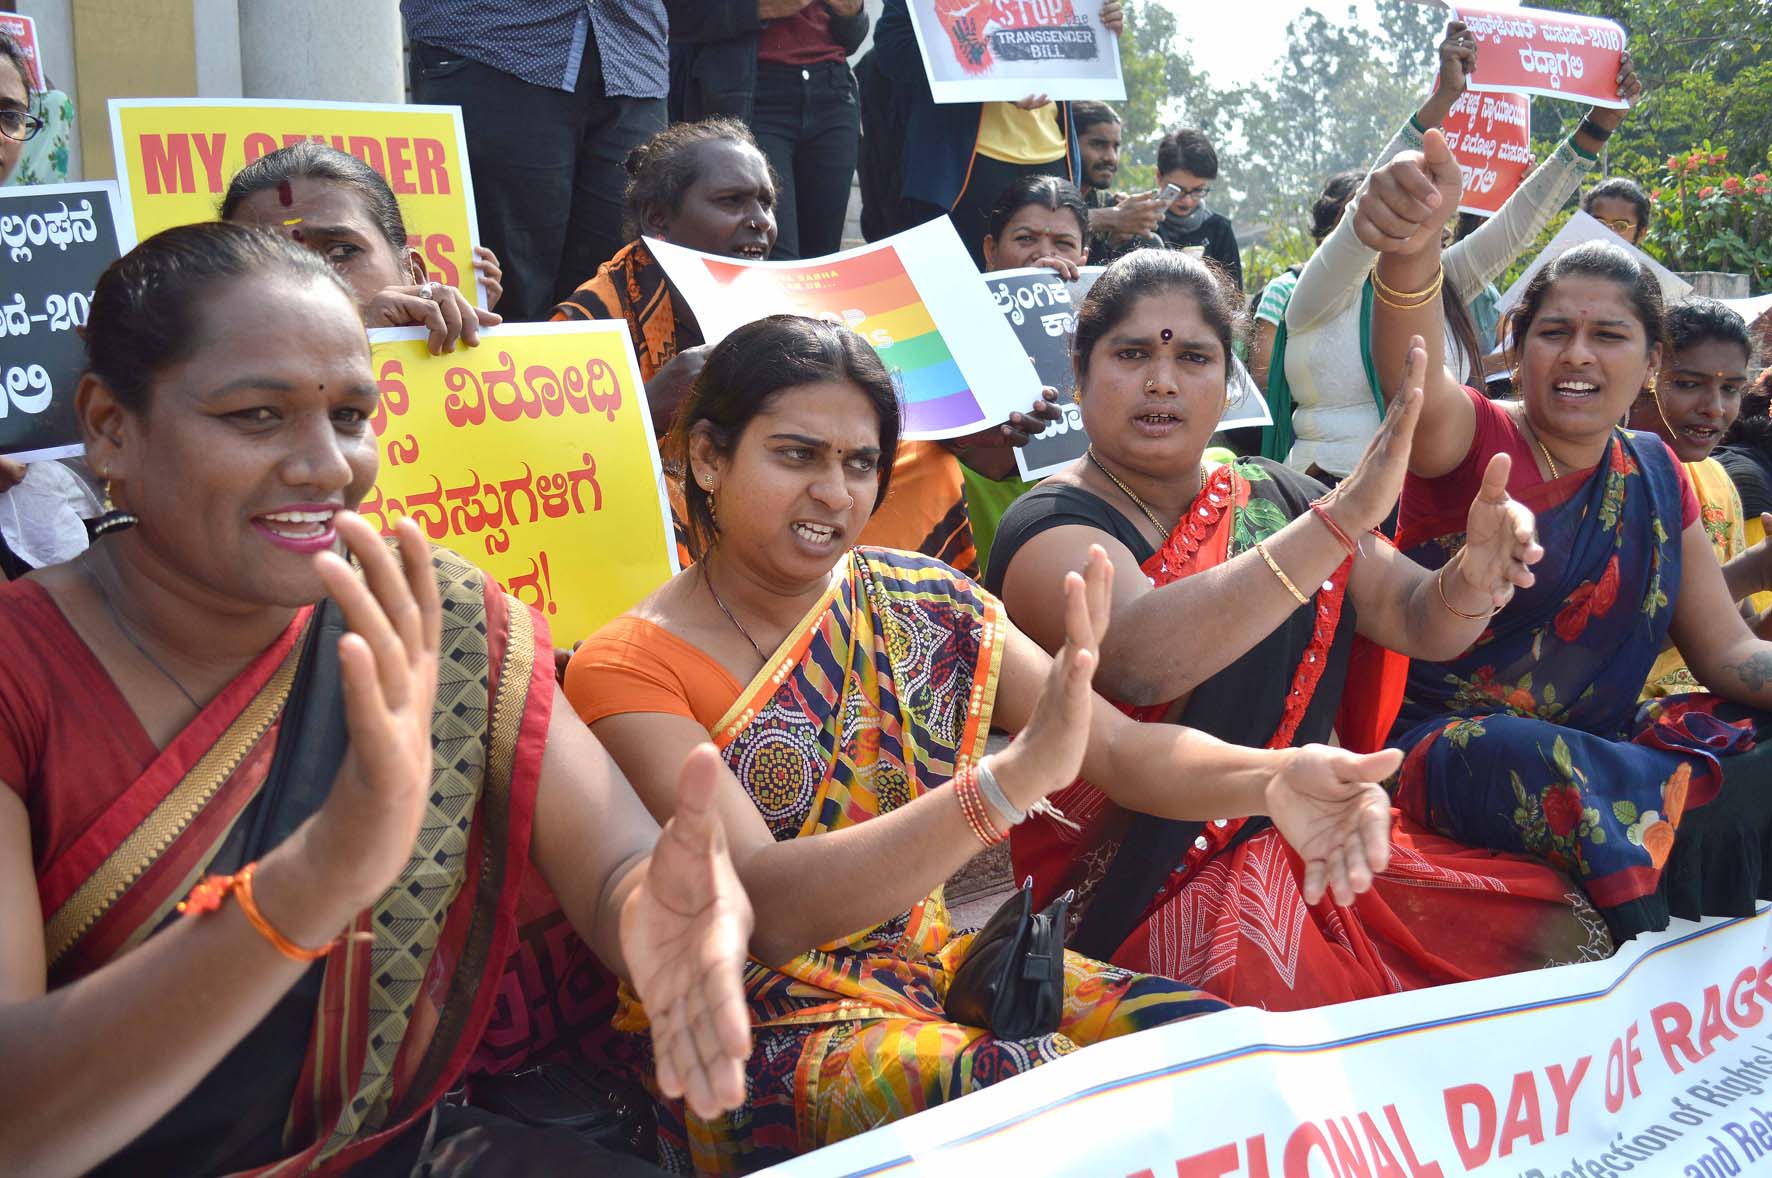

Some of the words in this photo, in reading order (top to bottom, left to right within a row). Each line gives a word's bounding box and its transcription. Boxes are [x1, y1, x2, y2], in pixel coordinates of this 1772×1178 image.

[994, 0, 1063, 27] STOP
[996, 31, 1093, 44] TRANSGENDER
[1030, 44, 1065, 59] BILL
[140, 133, 227, 194] MY
[0, 200, 98, 263] ಲ್ಲಂಘನೆ
[443, 351, 622, 428] ವಿರೋಧಿ
[1443, 1055, 1593, 1172] DAY
[1604, 1018, 1643, 1114] OF
[1669, 1096, 1713, 1126] of
